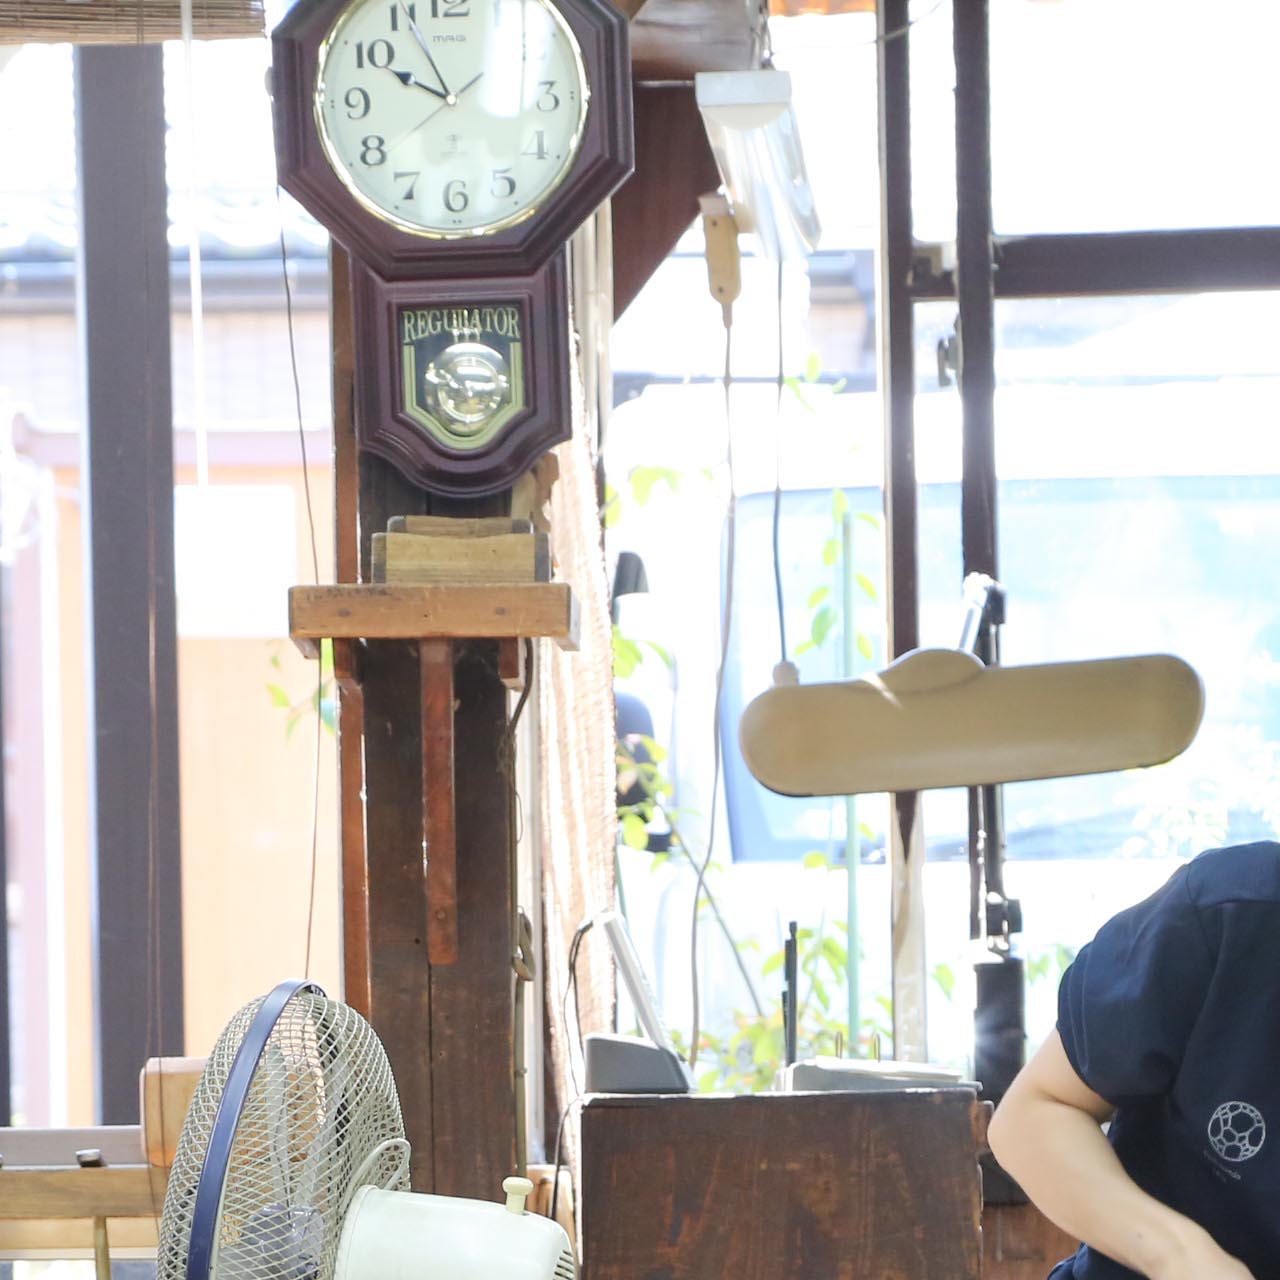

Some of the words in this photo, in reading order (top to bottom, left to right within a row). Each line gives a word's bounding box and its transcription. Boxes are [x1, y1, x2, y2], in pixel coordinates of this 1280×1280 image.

[389, 2, 417, 32] 11
[356, 38, 396, 69] 10
[344, 86, 371, 120] 9
[536, 80, 561, 112] 3
[360, 134, 387, 166] 8
[521, 130, 549, 160] 4
[393, 171, 421, 201] 7
[443, 179, 469, 213] 6
[490, 167, 516, 198] 5
[402, 307, 520, 343] REGULATOR
